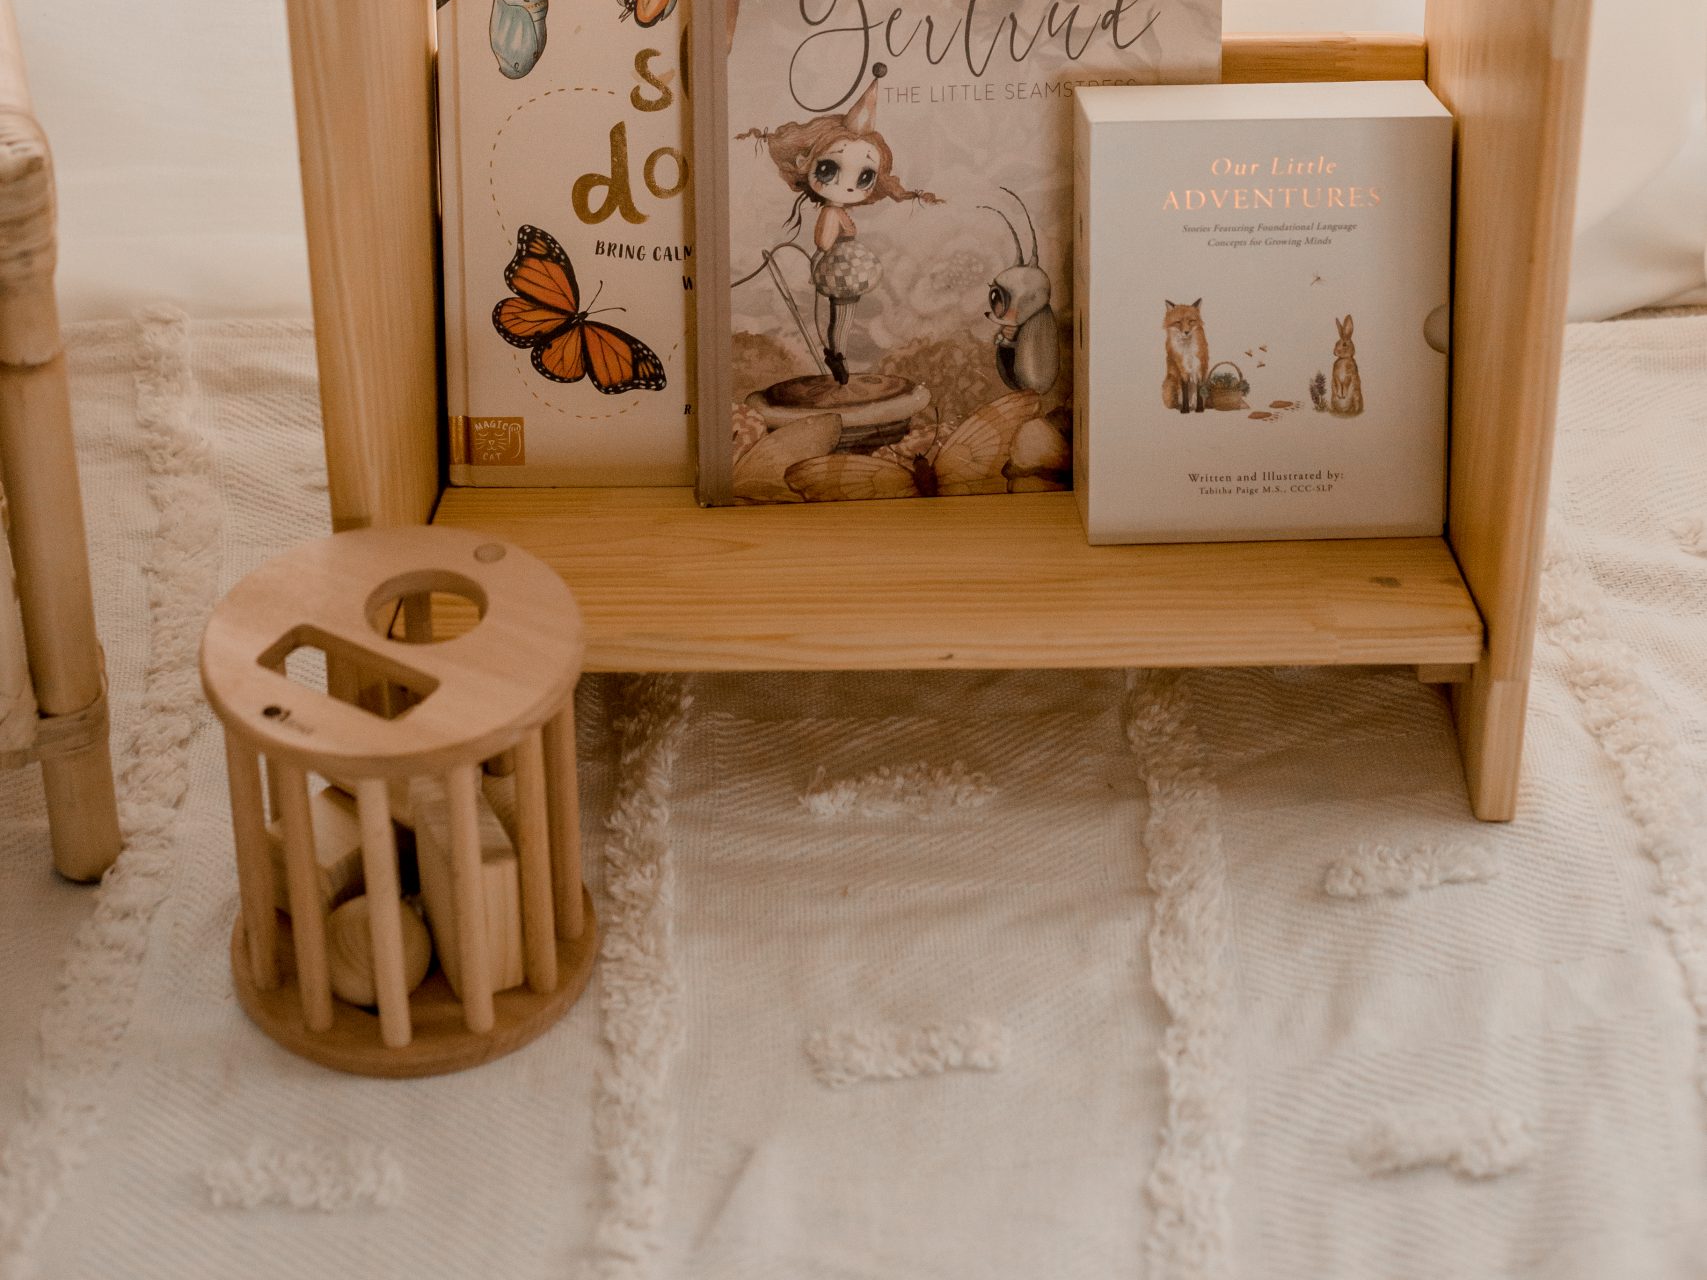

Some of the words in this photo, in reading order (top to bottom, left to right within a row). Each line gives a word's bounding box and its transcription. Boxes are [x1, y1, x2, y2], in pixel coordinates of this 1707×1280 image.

[884, 86, 921, 103] THE
[930, 83, 995, 103] LITTLE
[1004, 78, 1137, 100] SEAMS
[1211, 157, 1261, 176] Our
[1271, 155, 1338, 176] Little
[1162, 187, 1382, 210] ADVENTURES
[1182, 224, 1211, 233] Stories
[1213, 223, 1255, 234] Featuring
[1257, 222, 1315, 232] Foundational
[1316, 222, 1358, 233] Language
[1207, 238, 1248, 249] Concepts
[1249, 237, 1263, 248] for
[1264, 237, 1303, 248] Growing
[1304, 236, 1332, 246] Minds
[595, 240, 647, 262] BRING
[474, 420, 509, 432] MAGIC
[482, 452, 502, 461] CAT
[1188, 472, 1232, 483] Written
[1236, 471, 1257, 482] and
[1262, 470, 1322, 482] Illustrated
[1327, 470, 1345, 482] by:
[1199, 486, 1232, 495] Tabitha
[1236, 486, 1259, 495] Paige
[1290, 483, 1334, 494] CCC-SLP
